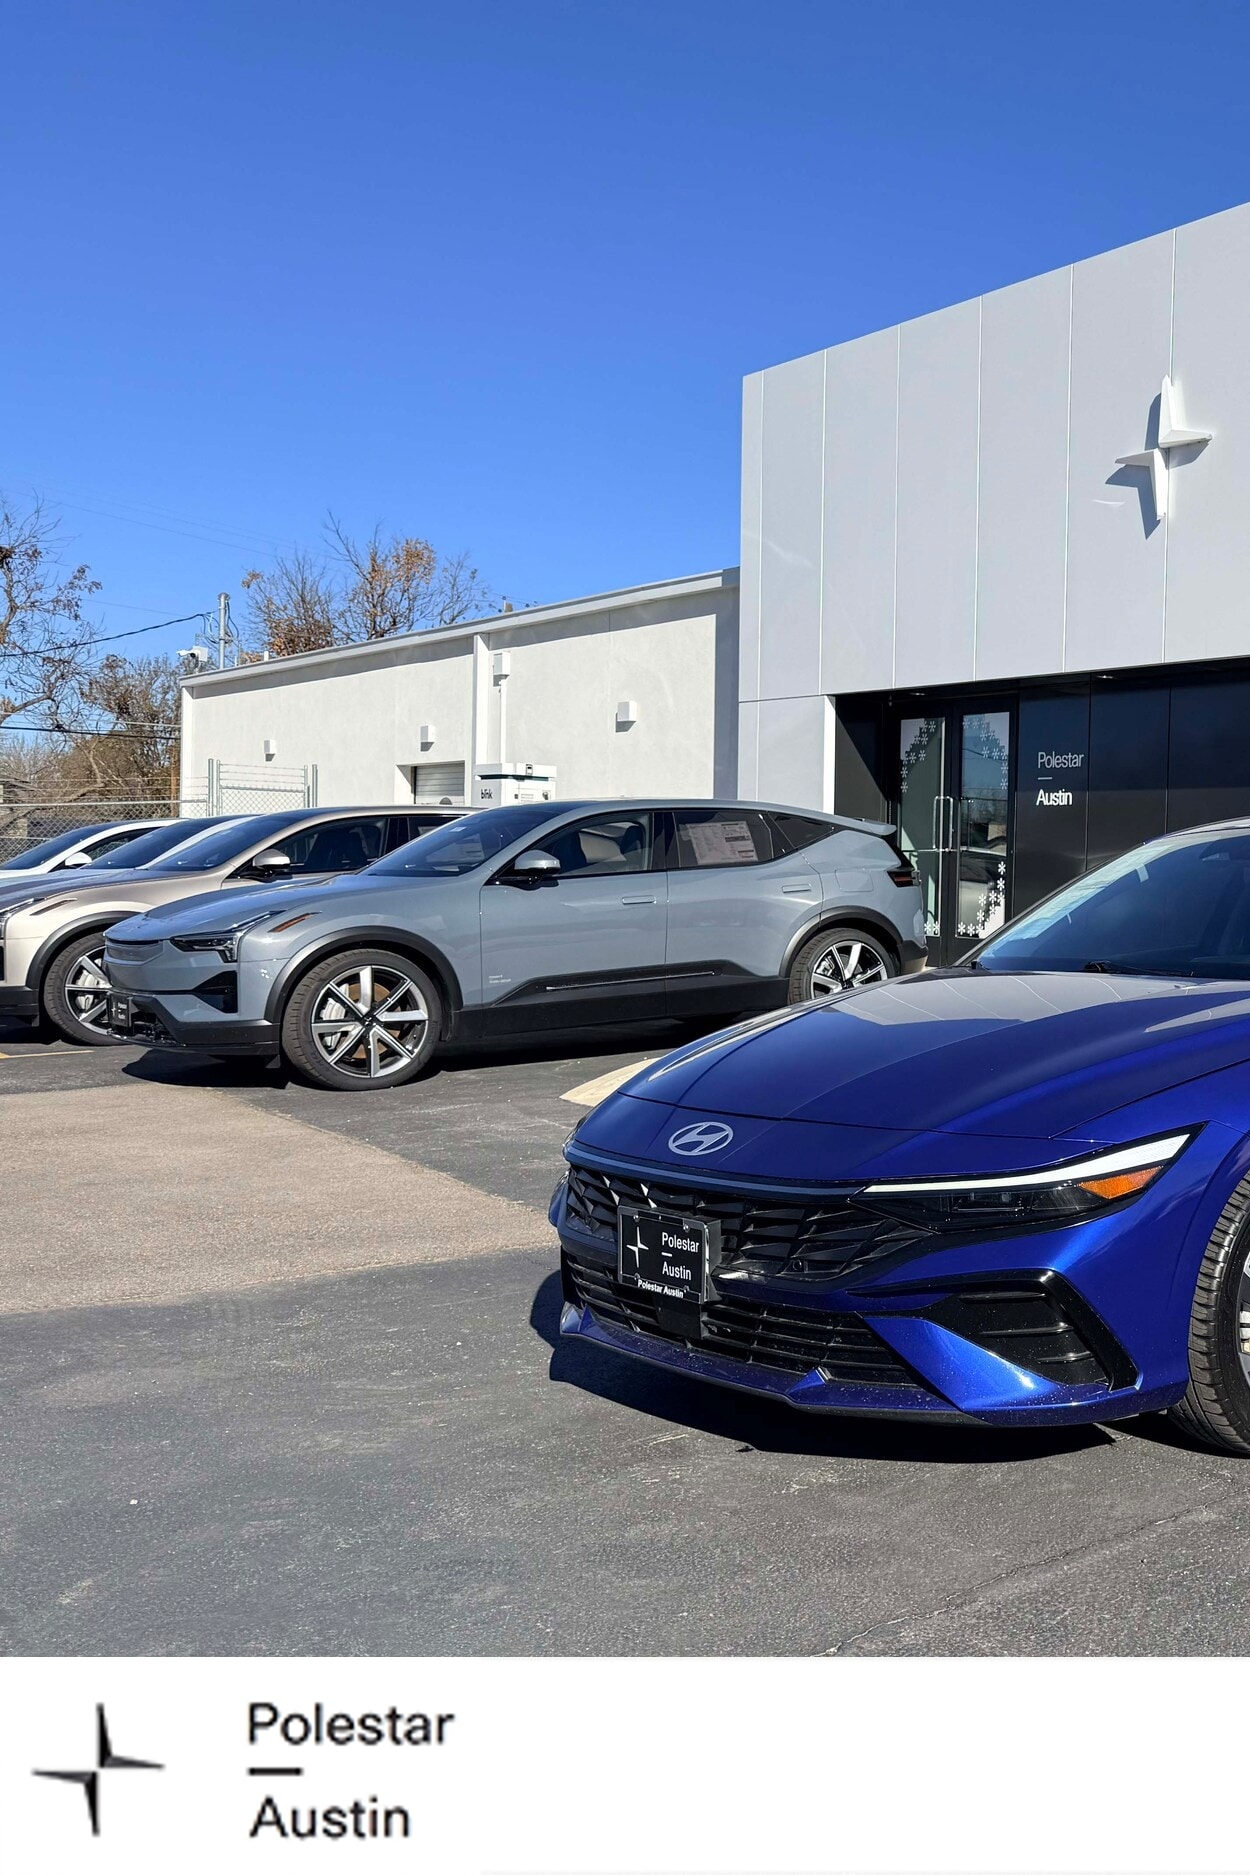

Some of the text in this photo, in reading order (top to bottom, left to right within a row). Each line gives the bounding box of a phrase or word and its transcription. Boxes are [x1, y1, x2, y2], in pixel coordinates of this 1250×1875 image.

[1037, 751, 1084, 769] Polestar
[481, 789, 493, 799] blink
[1035, 788, 1073, 806] Austin
[661, 1231, 700, 1253] Polestar
[662, 1261, 692, 1281] Austin
[637, 1279, 684, 1299] Polestar Austin
